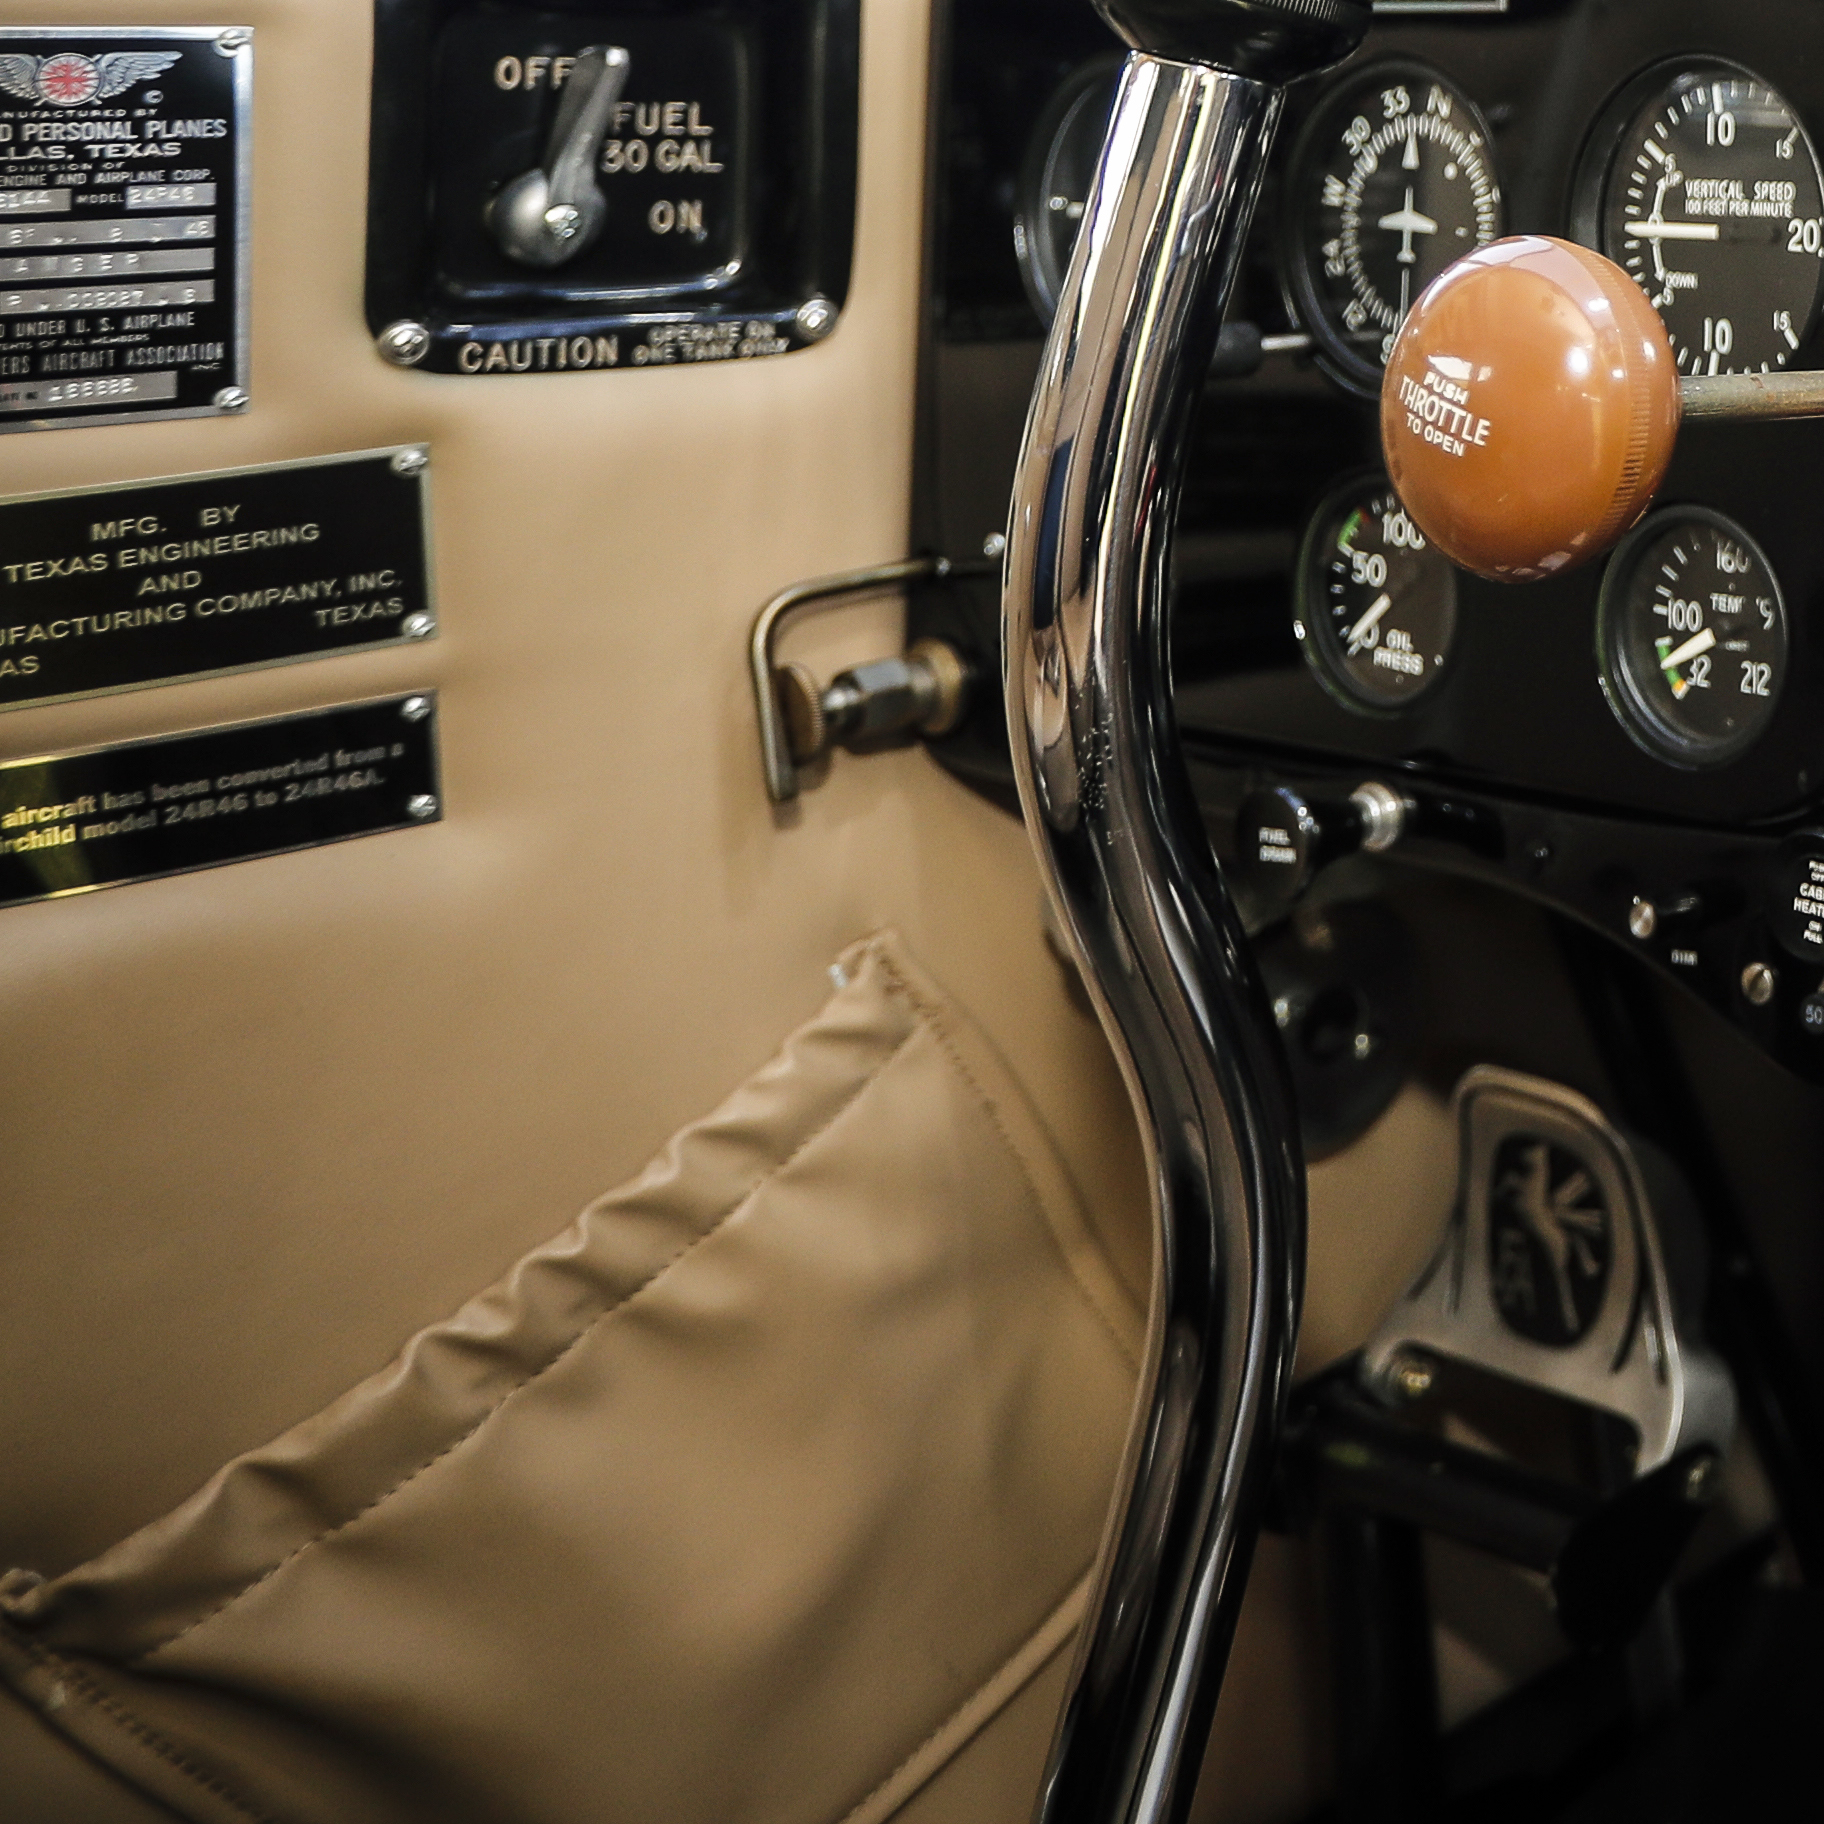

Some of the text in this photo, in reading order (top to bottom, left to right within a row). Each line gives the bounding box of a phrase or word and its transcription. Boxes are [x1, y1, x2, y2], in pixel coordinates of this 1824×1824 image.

[494, 56, 576, 91] OFF
[22, 119, 227, 142] PERSONAL PLANES
[612, 102, 714, 136] FUEL
[1707, 111, 1736, 146] 10
[84, 142, 182, 158] TEXAS
[602, 140, 723, 173] 30 GAL
[55, 173, 87, 184] AND
[94, 170, 166, 184] AIRPLANE
[1685, 178, 1796, 201] VERTICAL SPEED
[649, 200, 704, 233] ON
[1684, 198, 1794, 218] 100 FEET PER MINUTE
[123, 312, 195, 330] AIRPLANE
[458, 336, 619, 373] CAUTION
[1424, 371, 1469, 405] PUSH
[1399, 375, 1491, 447] THROTTLE
[1406, 412, 1465, 457] TO OPEN
[91, 504, 241, 542] MFG. BY
[4, 523, 321, 584] TEXAS ENGINEERING
[1351, 551, 1388, 588] 50
[138, 571, 202, 596] AND
[195, 578, 342, 617] COMPANY,
[347, 569, 402, 592] INC.
[314, 597, 404, 630] TEXAS
[1668, 598, 1703, 633] 100
[1740, 660, 1772, 696] 212
[2, 795, 97, 827] aircraft
[102, 791, 146, 810] has
